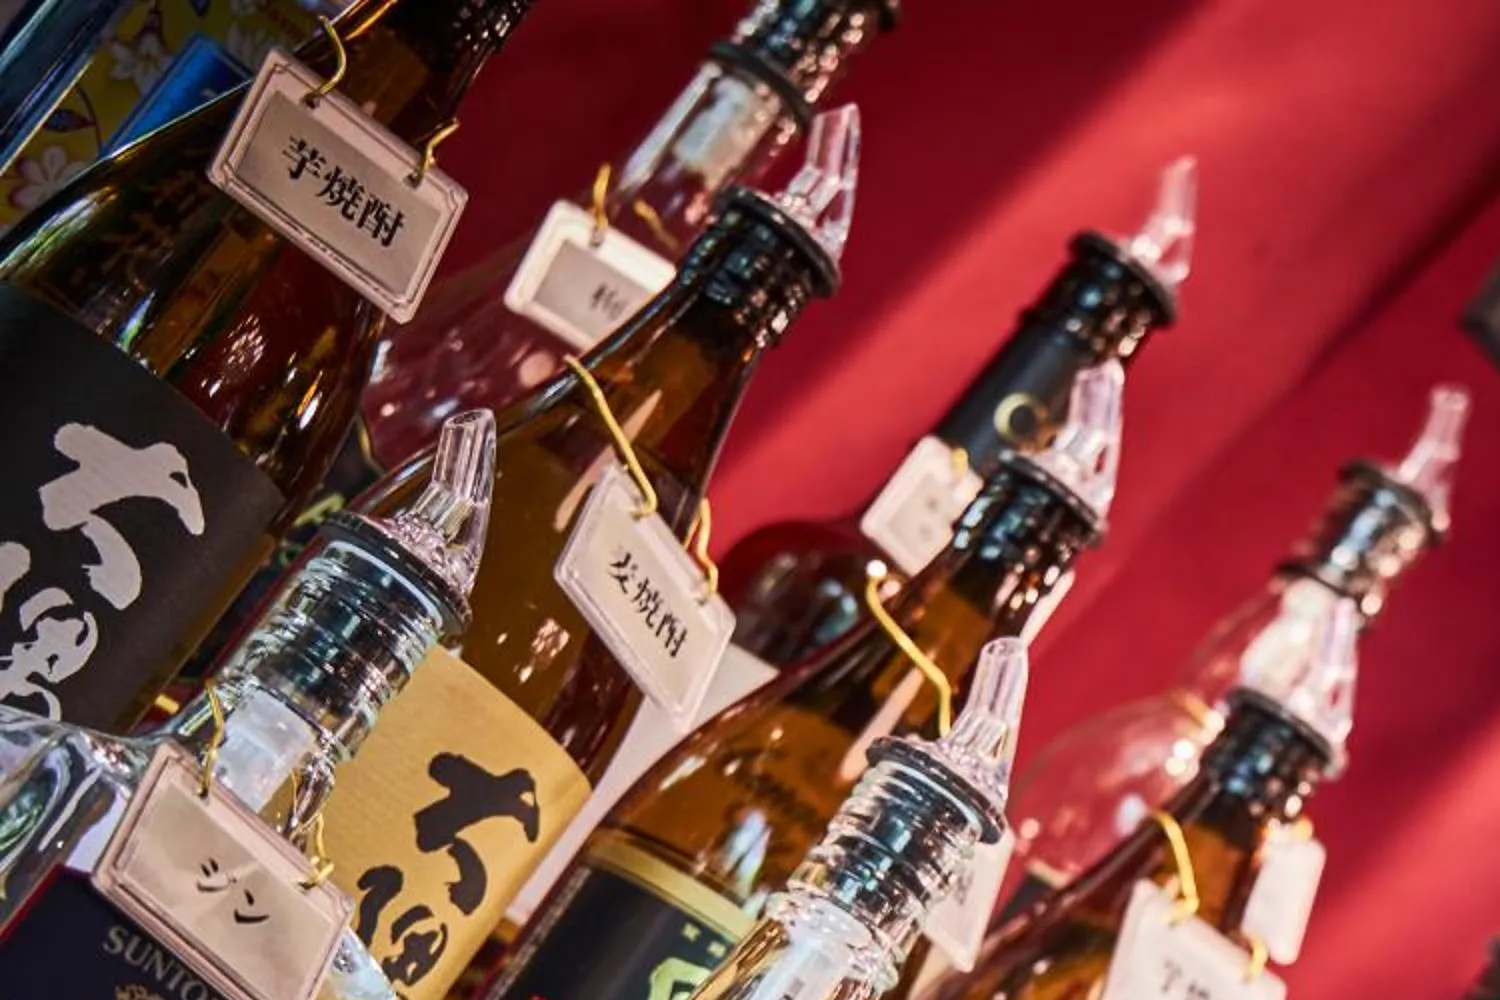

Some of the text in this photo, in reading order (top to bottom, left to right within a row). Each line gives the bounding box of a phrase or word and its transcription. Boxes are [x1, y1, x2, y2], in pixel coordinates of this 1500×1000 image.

[281, 134, 405, 248] 芋焼酎
[195, 856, 270, 926] ジン
